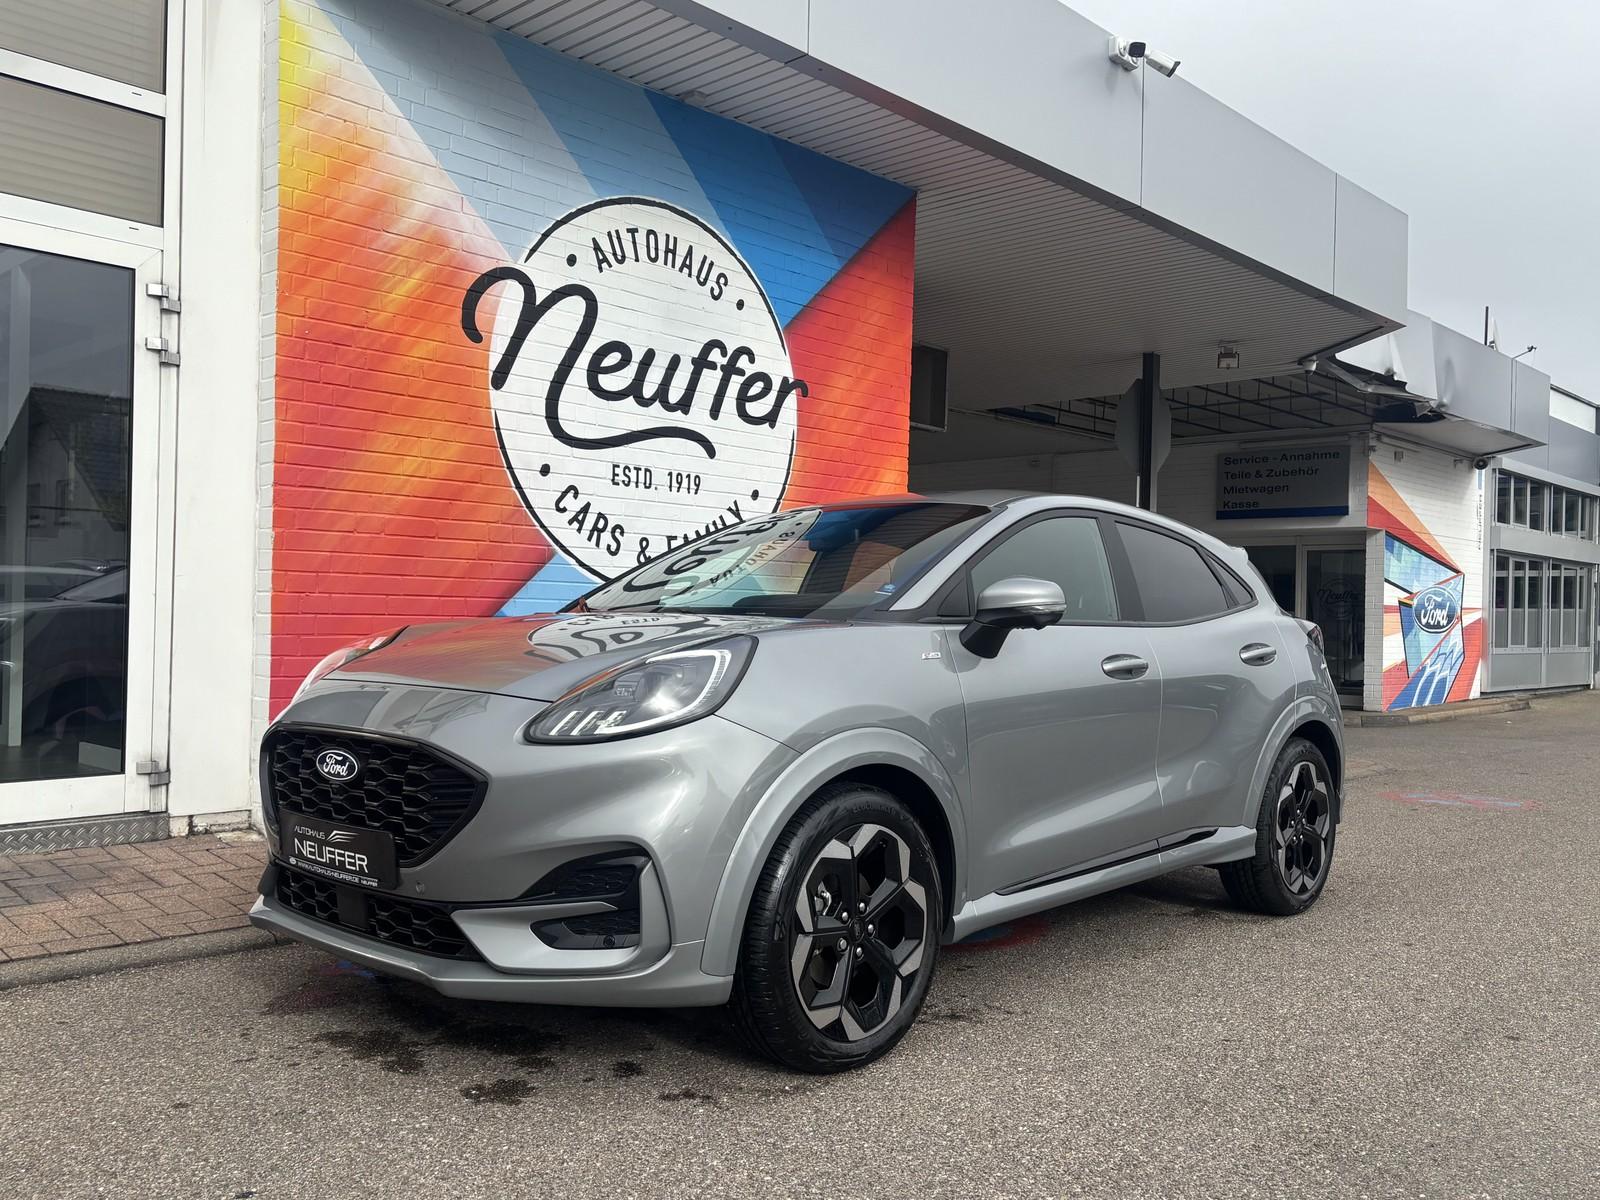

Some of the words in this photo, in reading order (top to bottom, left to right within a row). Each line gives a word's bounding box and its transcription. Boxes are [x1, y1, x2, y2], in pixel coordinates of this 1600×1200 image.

[591, 227, 728, 301] AUTOHAUS
[462, 266, 809, 459] Neuffer
[1223, 455, 1269, 466] Service
[1280, 450, 1340, 462] Annahme
[611, 464, 658, 491] ESTD.
[667, 471, 702, 496] 1919
[1224, 470, 1251, 480] Teile
[1254, 469, 1263, 479] &
[1266, 467, 1320, 478] Zubehör
[1223, 484, 1289, 495] Mietwagen
[1223, 500, 1260, 510] Kasse
[554, 484, 626, 557] CARS
[637, 537, 652, 566] &
[1421, 594, 1450, 627] Ford
[323, 753, 349, 777] Ford
[294, 825, 326, 840] AUTOHAUS
[294, 837, 369, 873] NEUFFER
